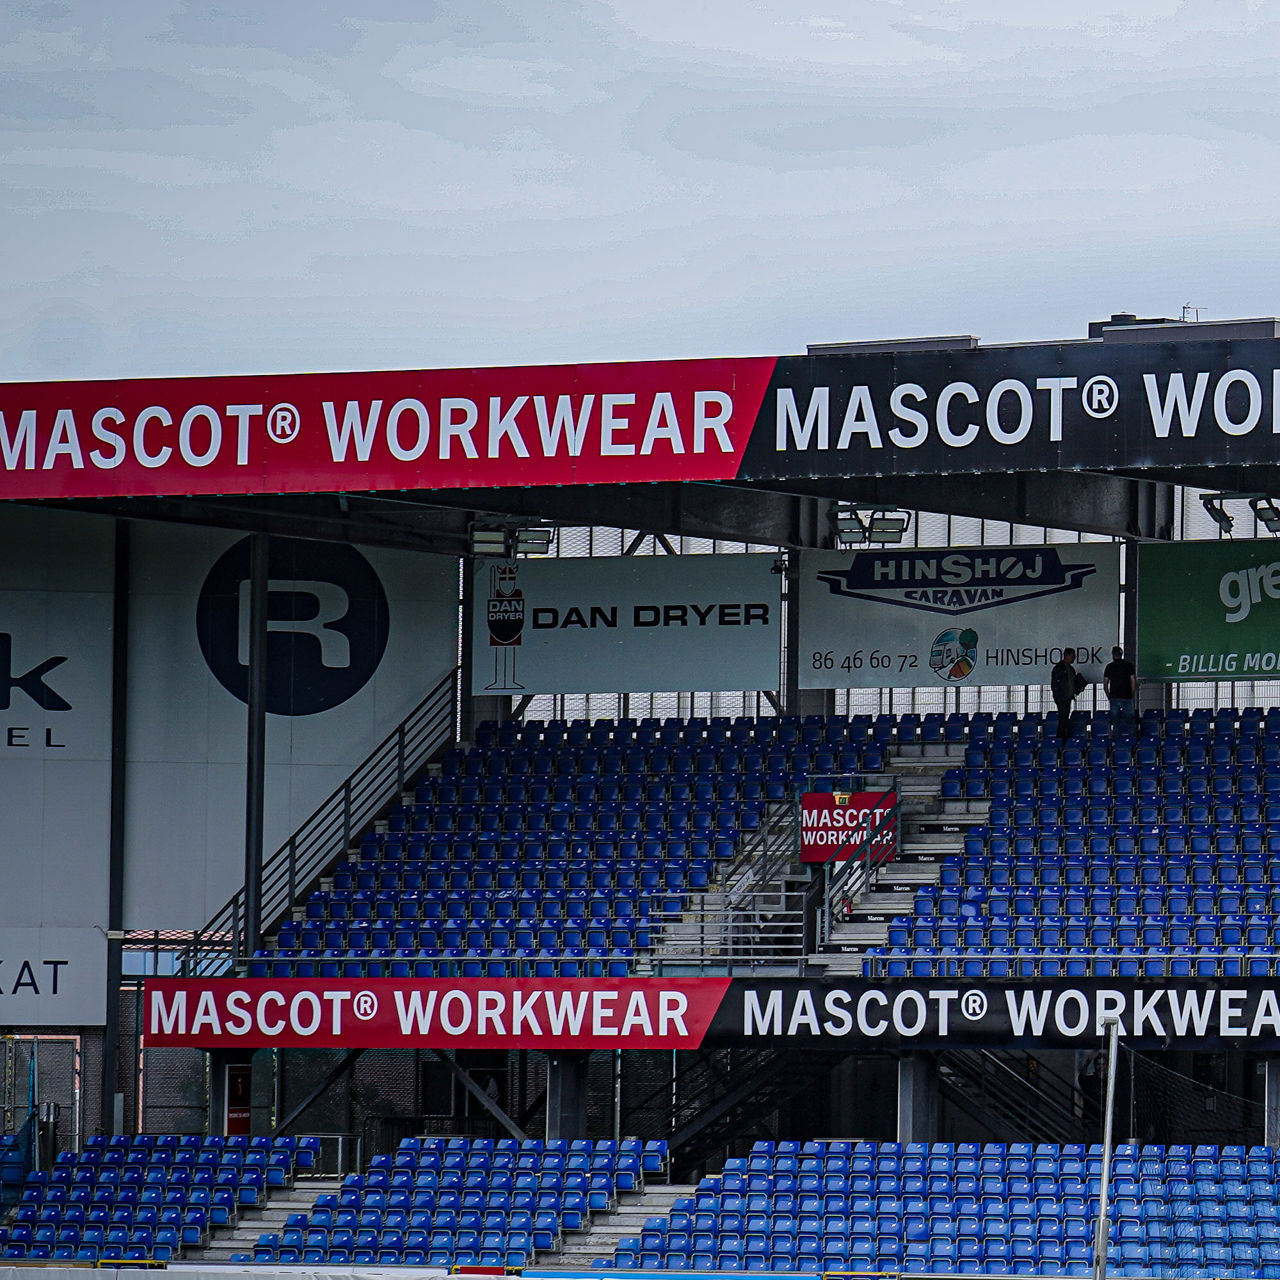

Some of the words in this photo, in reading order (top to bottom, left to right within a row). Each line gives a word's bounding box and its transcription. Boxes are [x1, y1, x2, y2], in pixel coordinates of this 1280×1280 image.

[322, 391, 735, 463] WORKWEAR
[489, 601, 523, 612] DAN
[489, 612, 524, 620] DRYER
[532, 606, 618, 629] DAN
[634, 604, 770, 627] DRYER
[812, 651, 834, 670] 86
[841, 650, 863, 673] 46
[870, 650, 891, 668] 60
[898, 655, 918, 673] 72
[1178, 653, 1237, 673] BILLIG
[394, 989, 690, 1036] WORKWEAR
